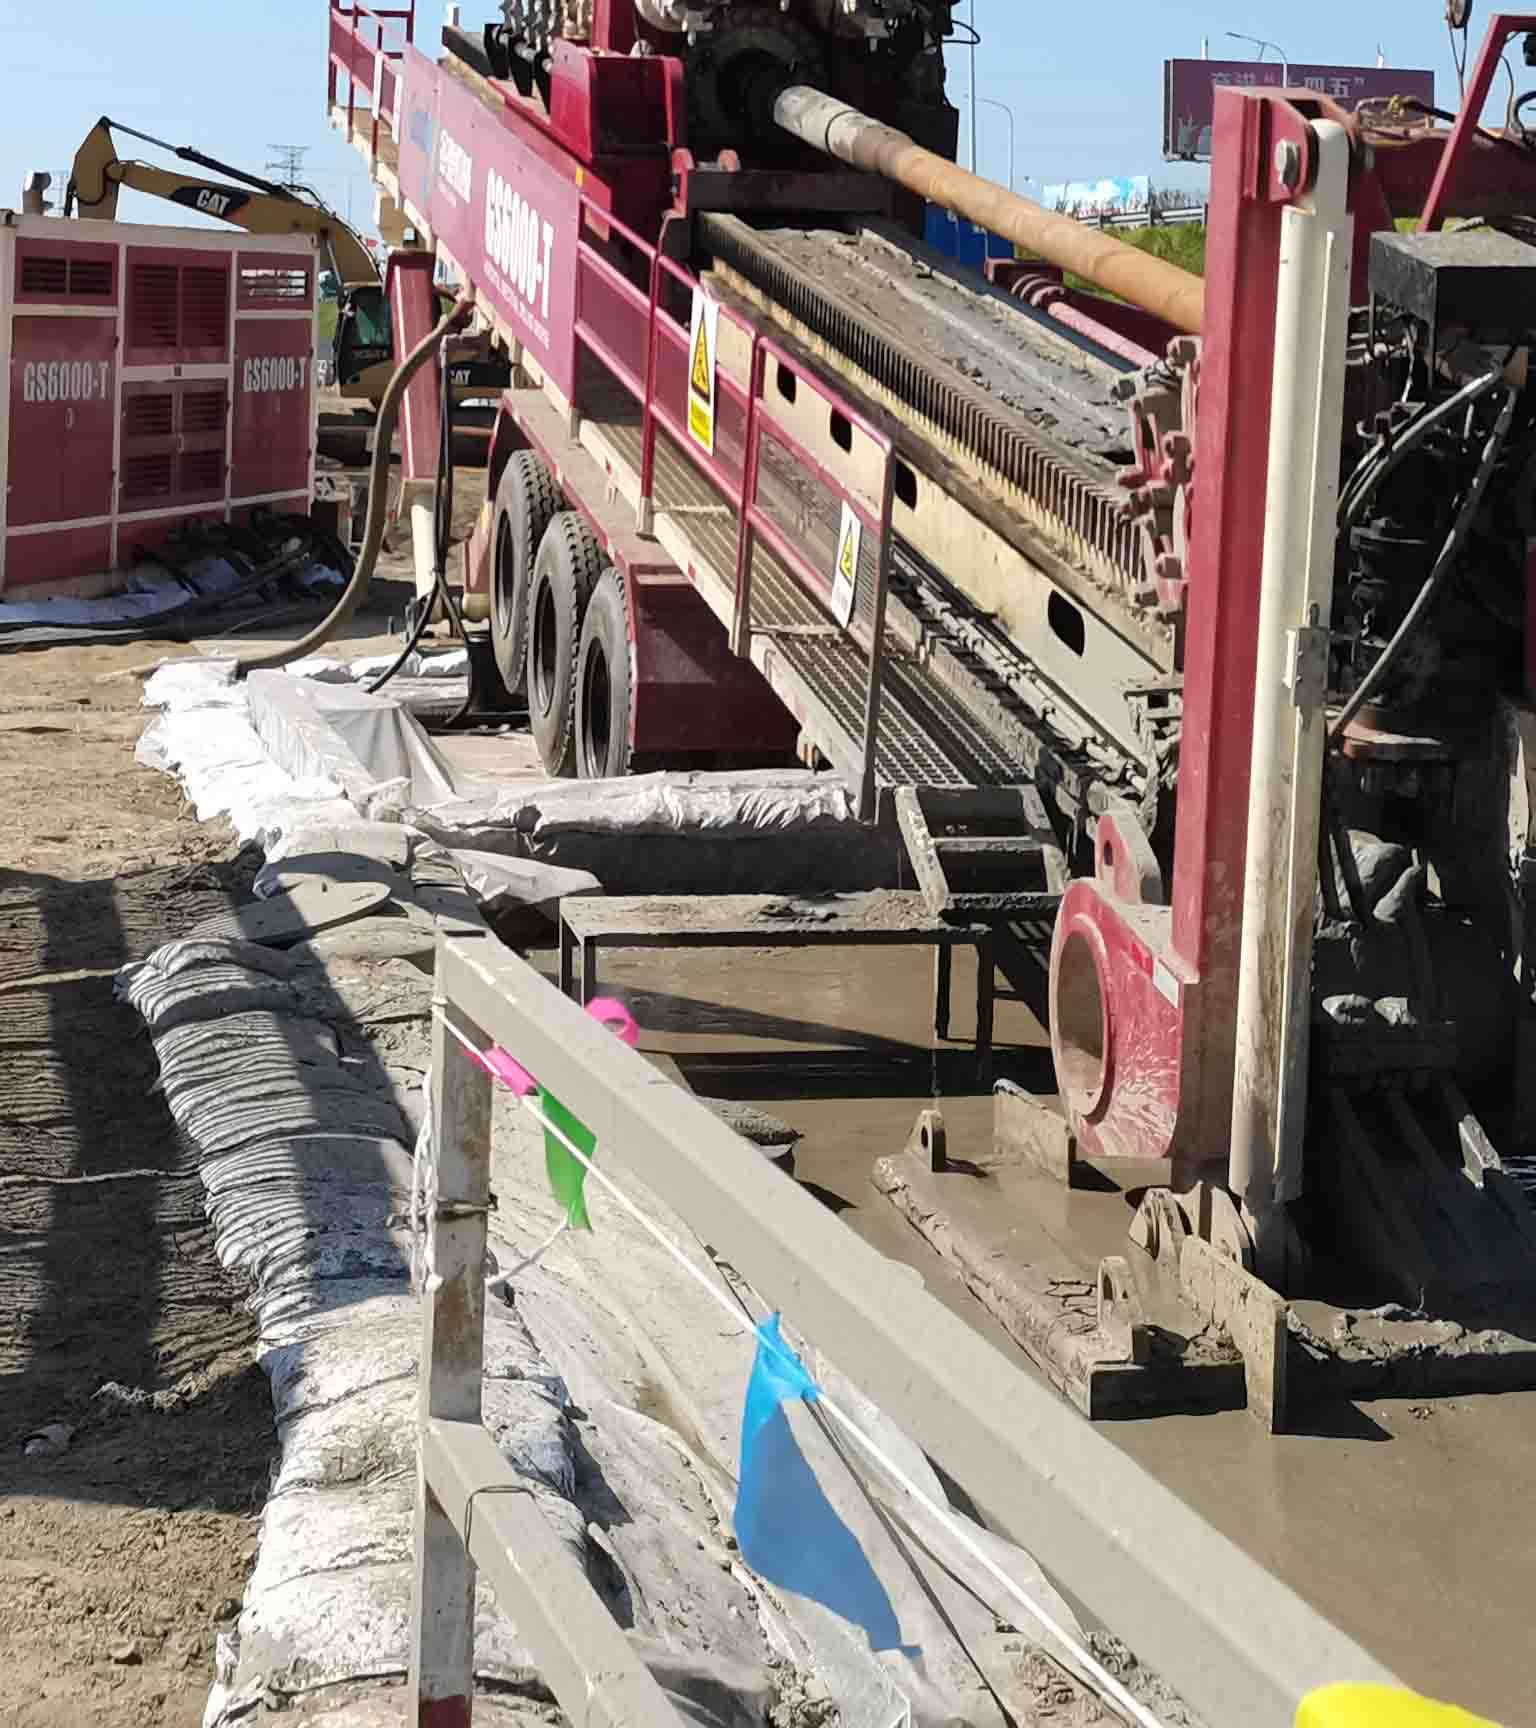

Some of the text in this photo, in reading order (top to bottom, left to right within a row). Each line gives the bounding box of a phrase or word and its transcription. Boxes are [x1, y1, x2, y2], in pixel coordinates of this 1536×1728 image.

[196, 189, 230, 216] CAT
[23, 360, 109, 401] GS6000-T
[243, 357, 306, 392] GS6000-T
